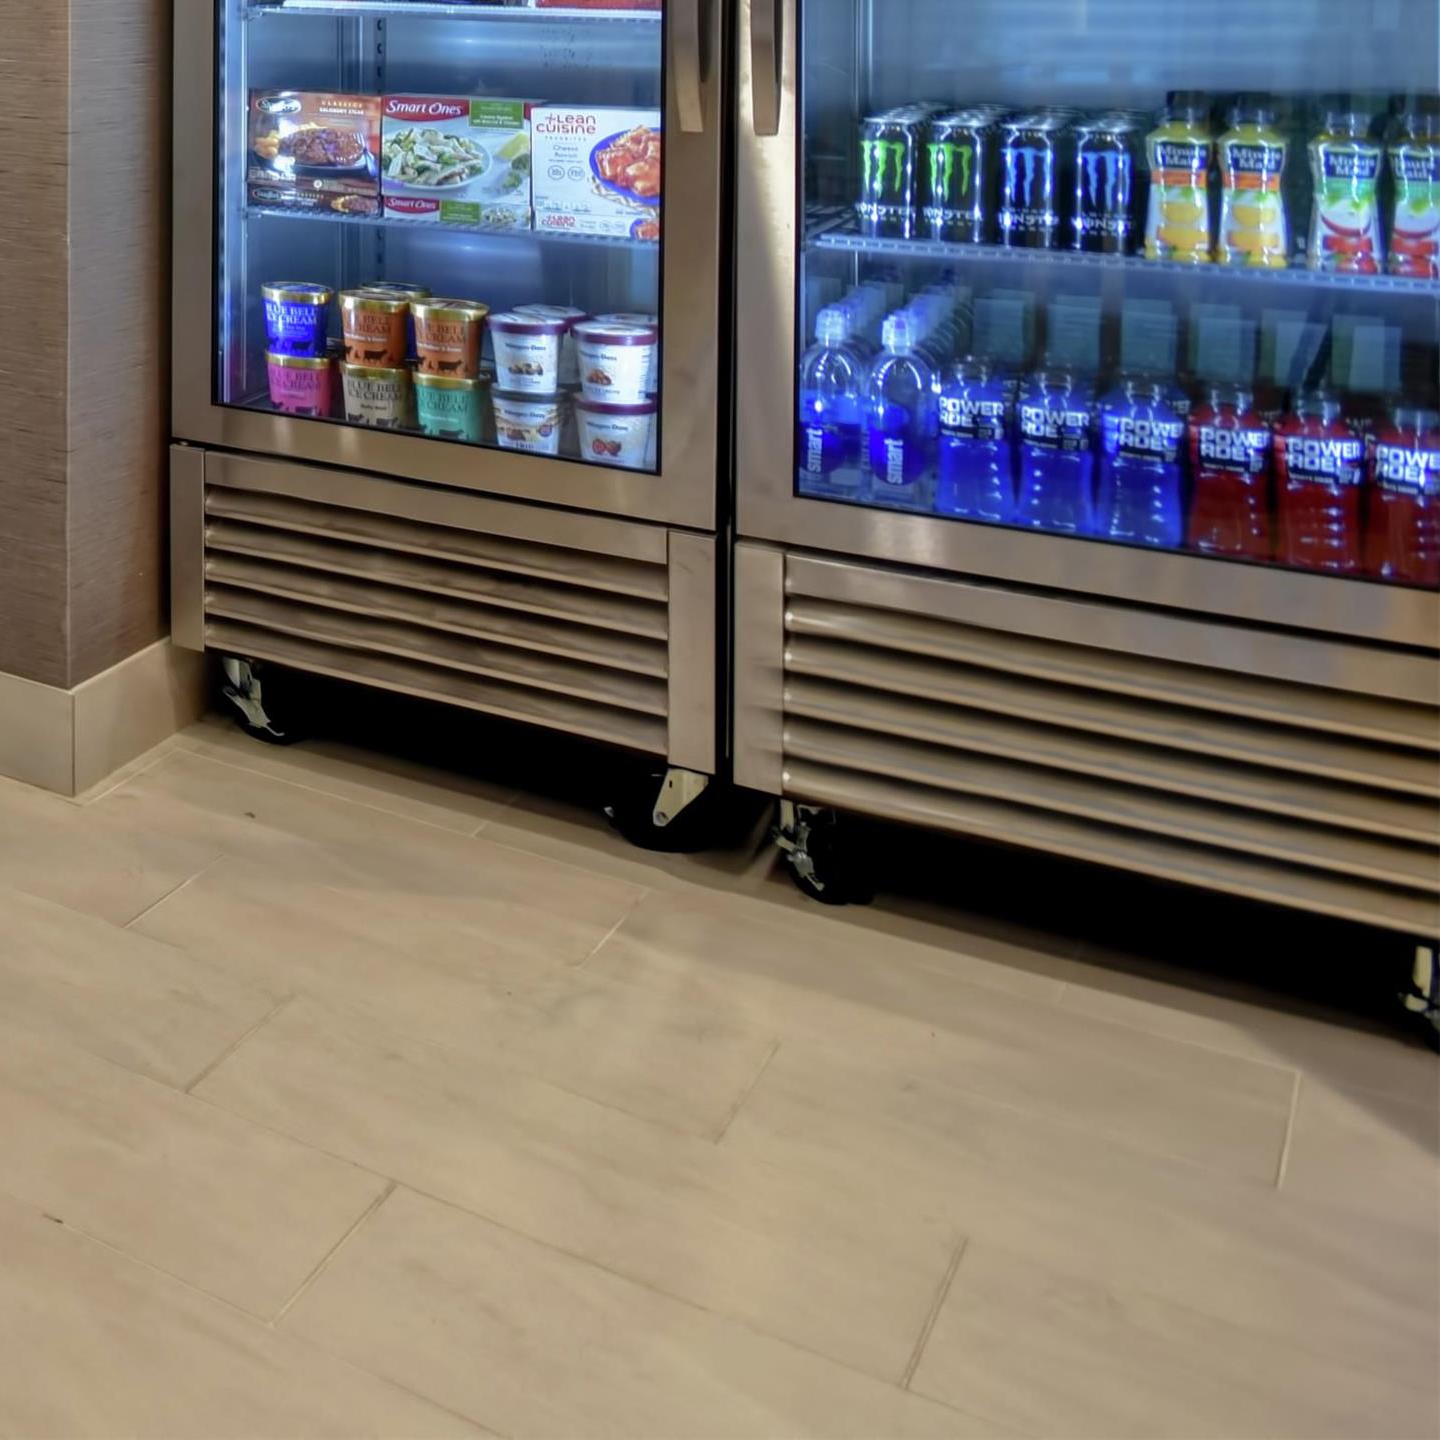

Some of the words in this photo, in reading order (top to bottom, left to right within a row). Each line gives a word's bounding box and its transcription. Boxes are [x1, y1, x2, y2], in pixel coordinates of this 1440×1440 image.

[385, 100, 426, 113] Smart
[428, 101, 463, 116] Ones
[939, 396, 1005, 417] POWER
[1020, 405, 1090, 427] POWER
[885, 437, 904, 485] smart
